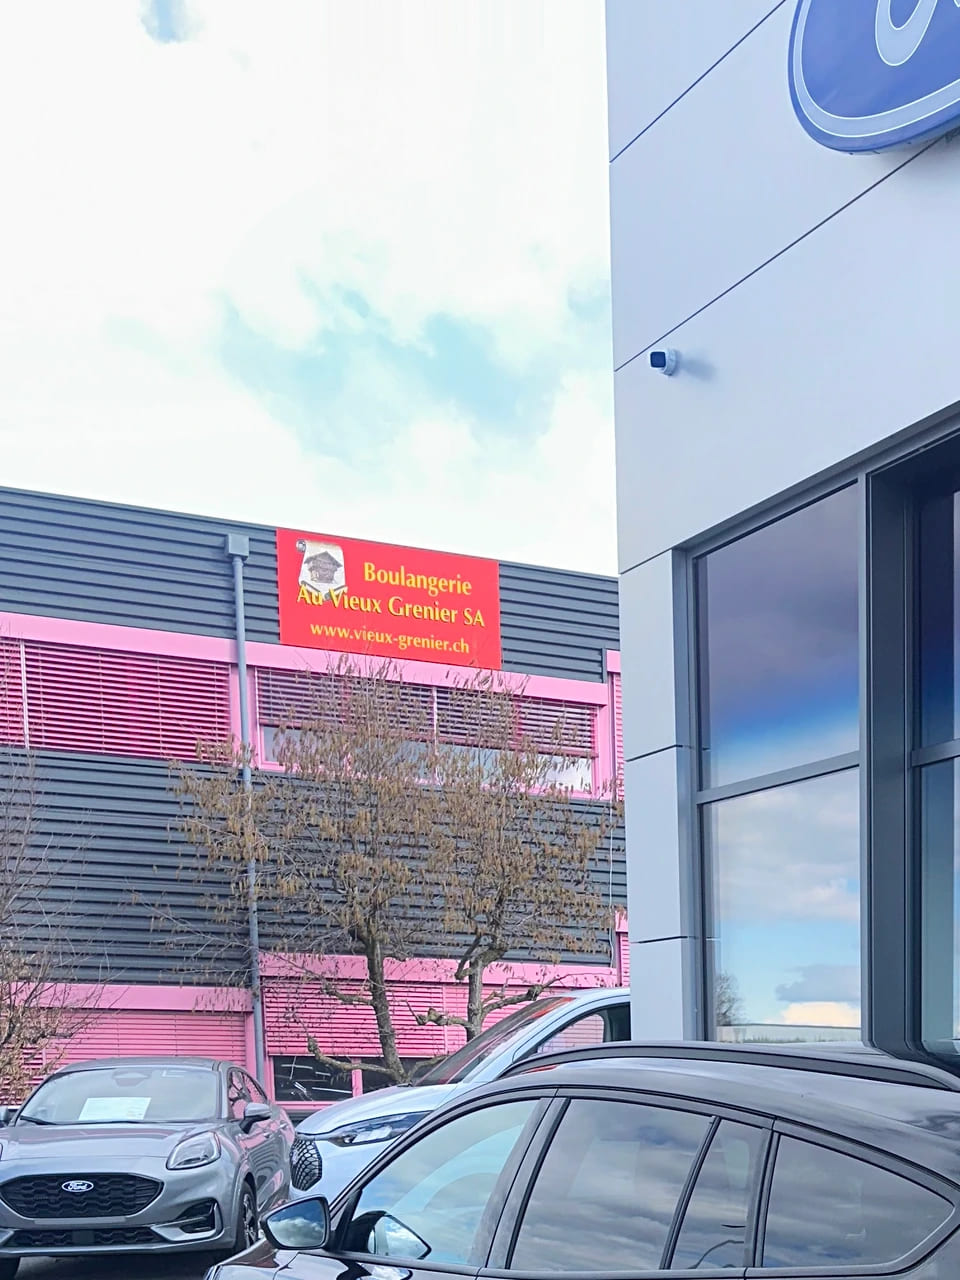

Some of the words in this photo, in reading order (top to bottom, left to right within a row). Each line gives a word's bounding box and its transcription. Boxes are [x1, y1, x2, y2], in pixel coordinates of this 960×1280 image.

[363, 561, 473, 597] Boulangerie
[297, 584, 323, 606] Au
[329, 586, 382, 614] Vieux
[388, 596, 458, 624] Grenier
[463, 608, 485, 627] SA
[310, 622, 470, 654] www.vieux-grenier.ch
